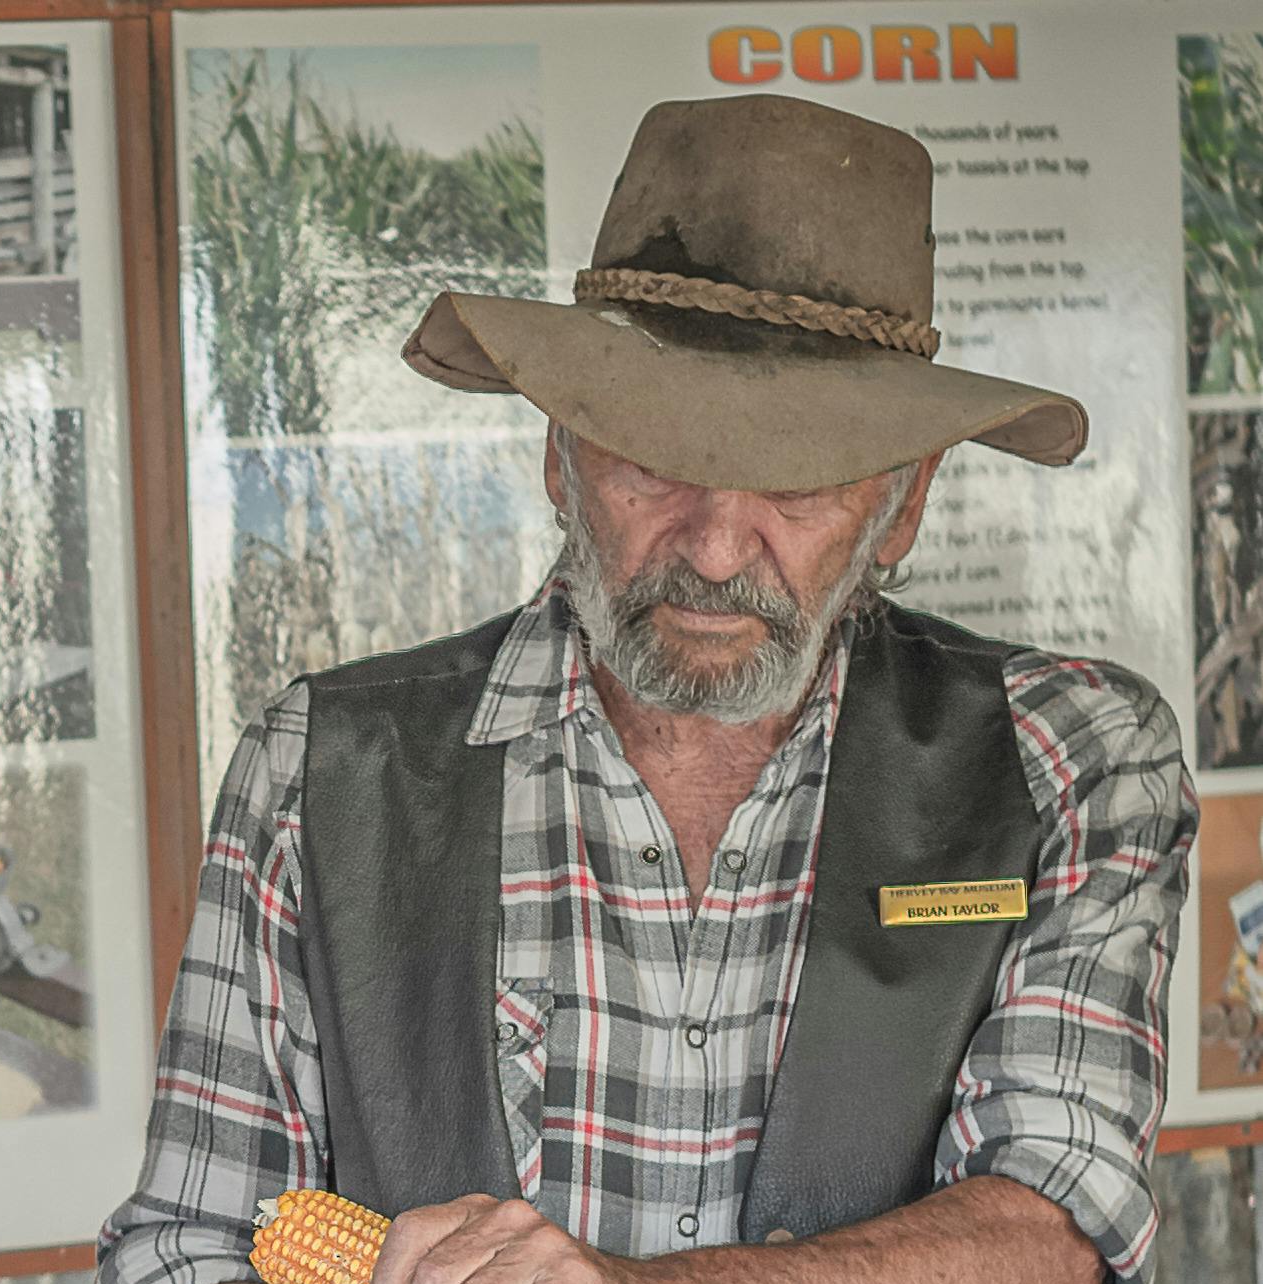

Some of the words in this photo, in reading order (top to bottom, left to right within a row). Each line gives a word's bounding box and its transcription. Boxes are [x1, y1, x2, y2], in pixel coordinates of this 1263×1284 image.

[708, 23, 1019, 85] CORN
[994, 121, 1010, 139] of
[907, 904, 947, 918] BRIAN
[951, 902, 1000, 916] TAYLOR
